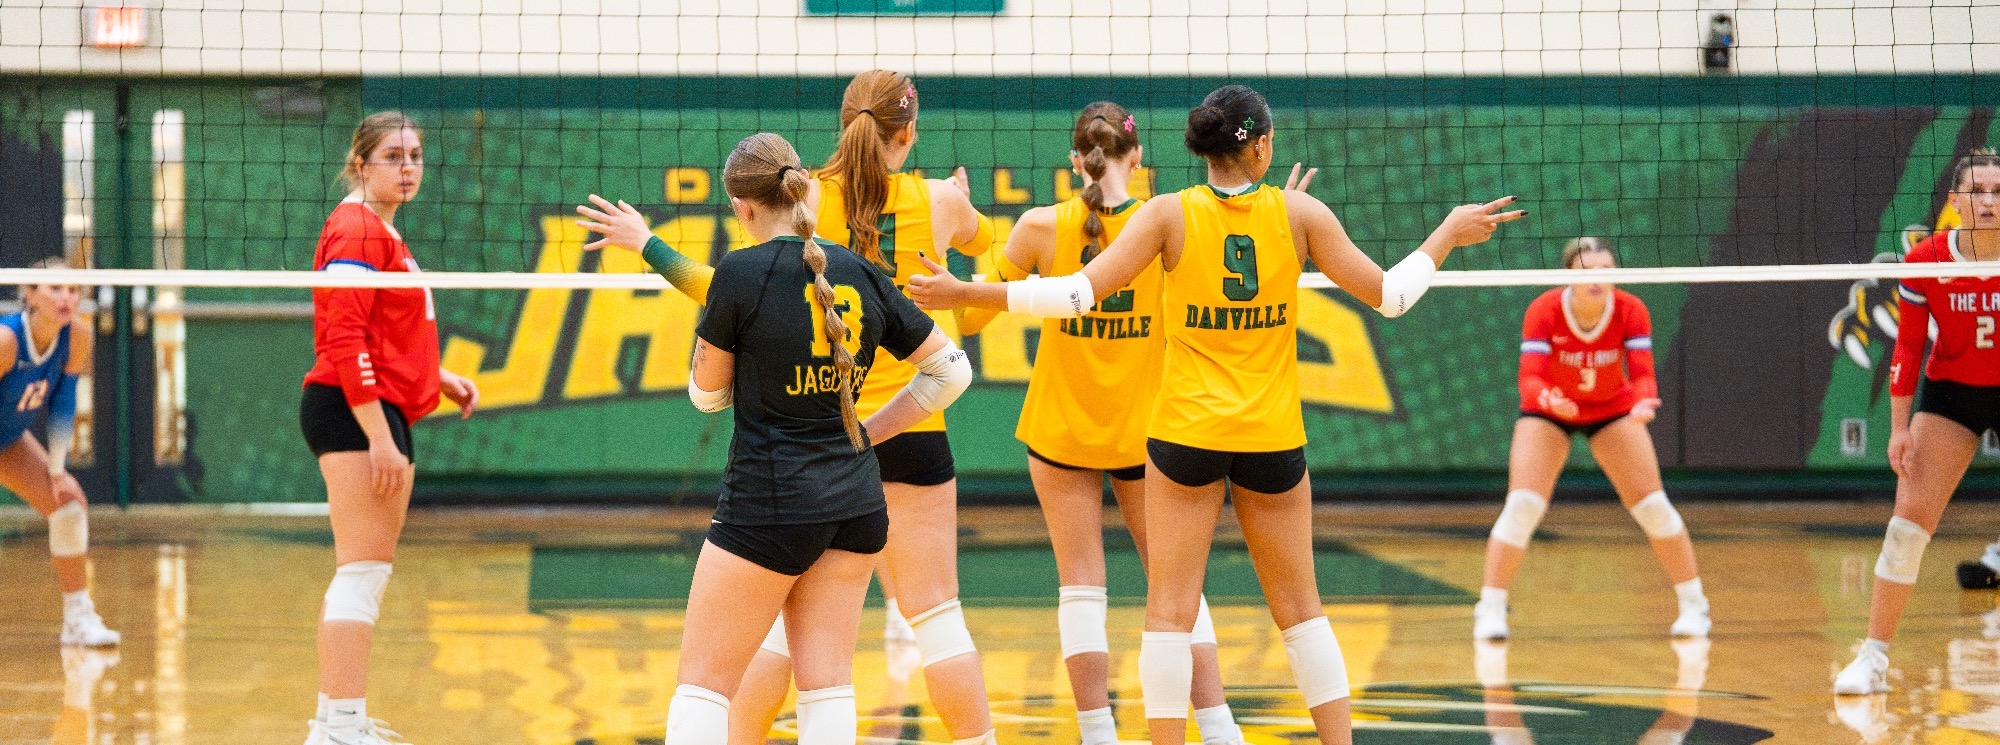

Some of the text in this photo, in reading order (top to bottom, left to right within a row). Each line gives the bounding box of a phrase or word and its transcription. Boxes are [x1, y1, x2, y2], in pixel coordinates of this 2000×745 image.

[1222, 234, 1259, 302] 9
[1185, 303, 1287, 330] DANVILLE
[1947, 291, 1978, 312] THE
[804, 282, 863, 357] 13
[1975, 315, 1996, 349] 2
[1577, 367, 1598, 393] 3
